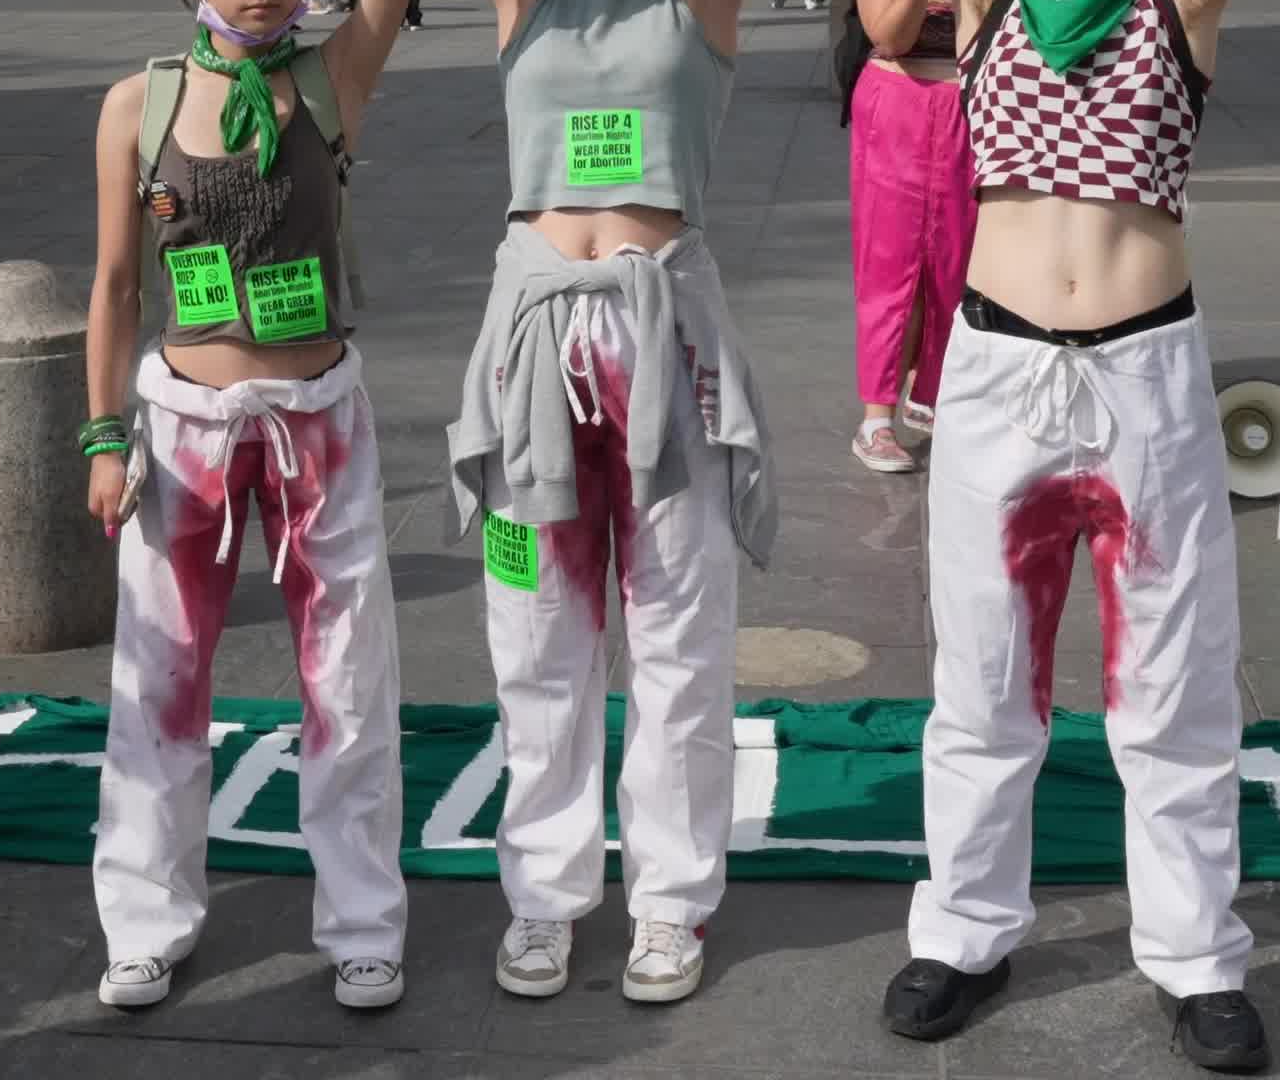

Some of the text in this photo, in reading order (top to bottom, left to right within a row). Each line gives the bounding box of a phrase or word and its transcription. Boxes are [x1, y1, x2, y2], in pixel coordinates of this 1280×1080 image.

[572, 113, 632, 131] RISE UP 4
[575, 143, 631, 156] WEAR GREEN
[590, 156, 632, 169] Abortion
[171, 250, 220, 270] OVERTURN
[251, 264, 312, 288] RISE UP 4
[178, 284, 229, 308] HELL NO!
[256, 294, 315, 314] WEAR GREEN
[276, 307, 317, 325] Abortion
[486, 511, 528, 542] FORCED
